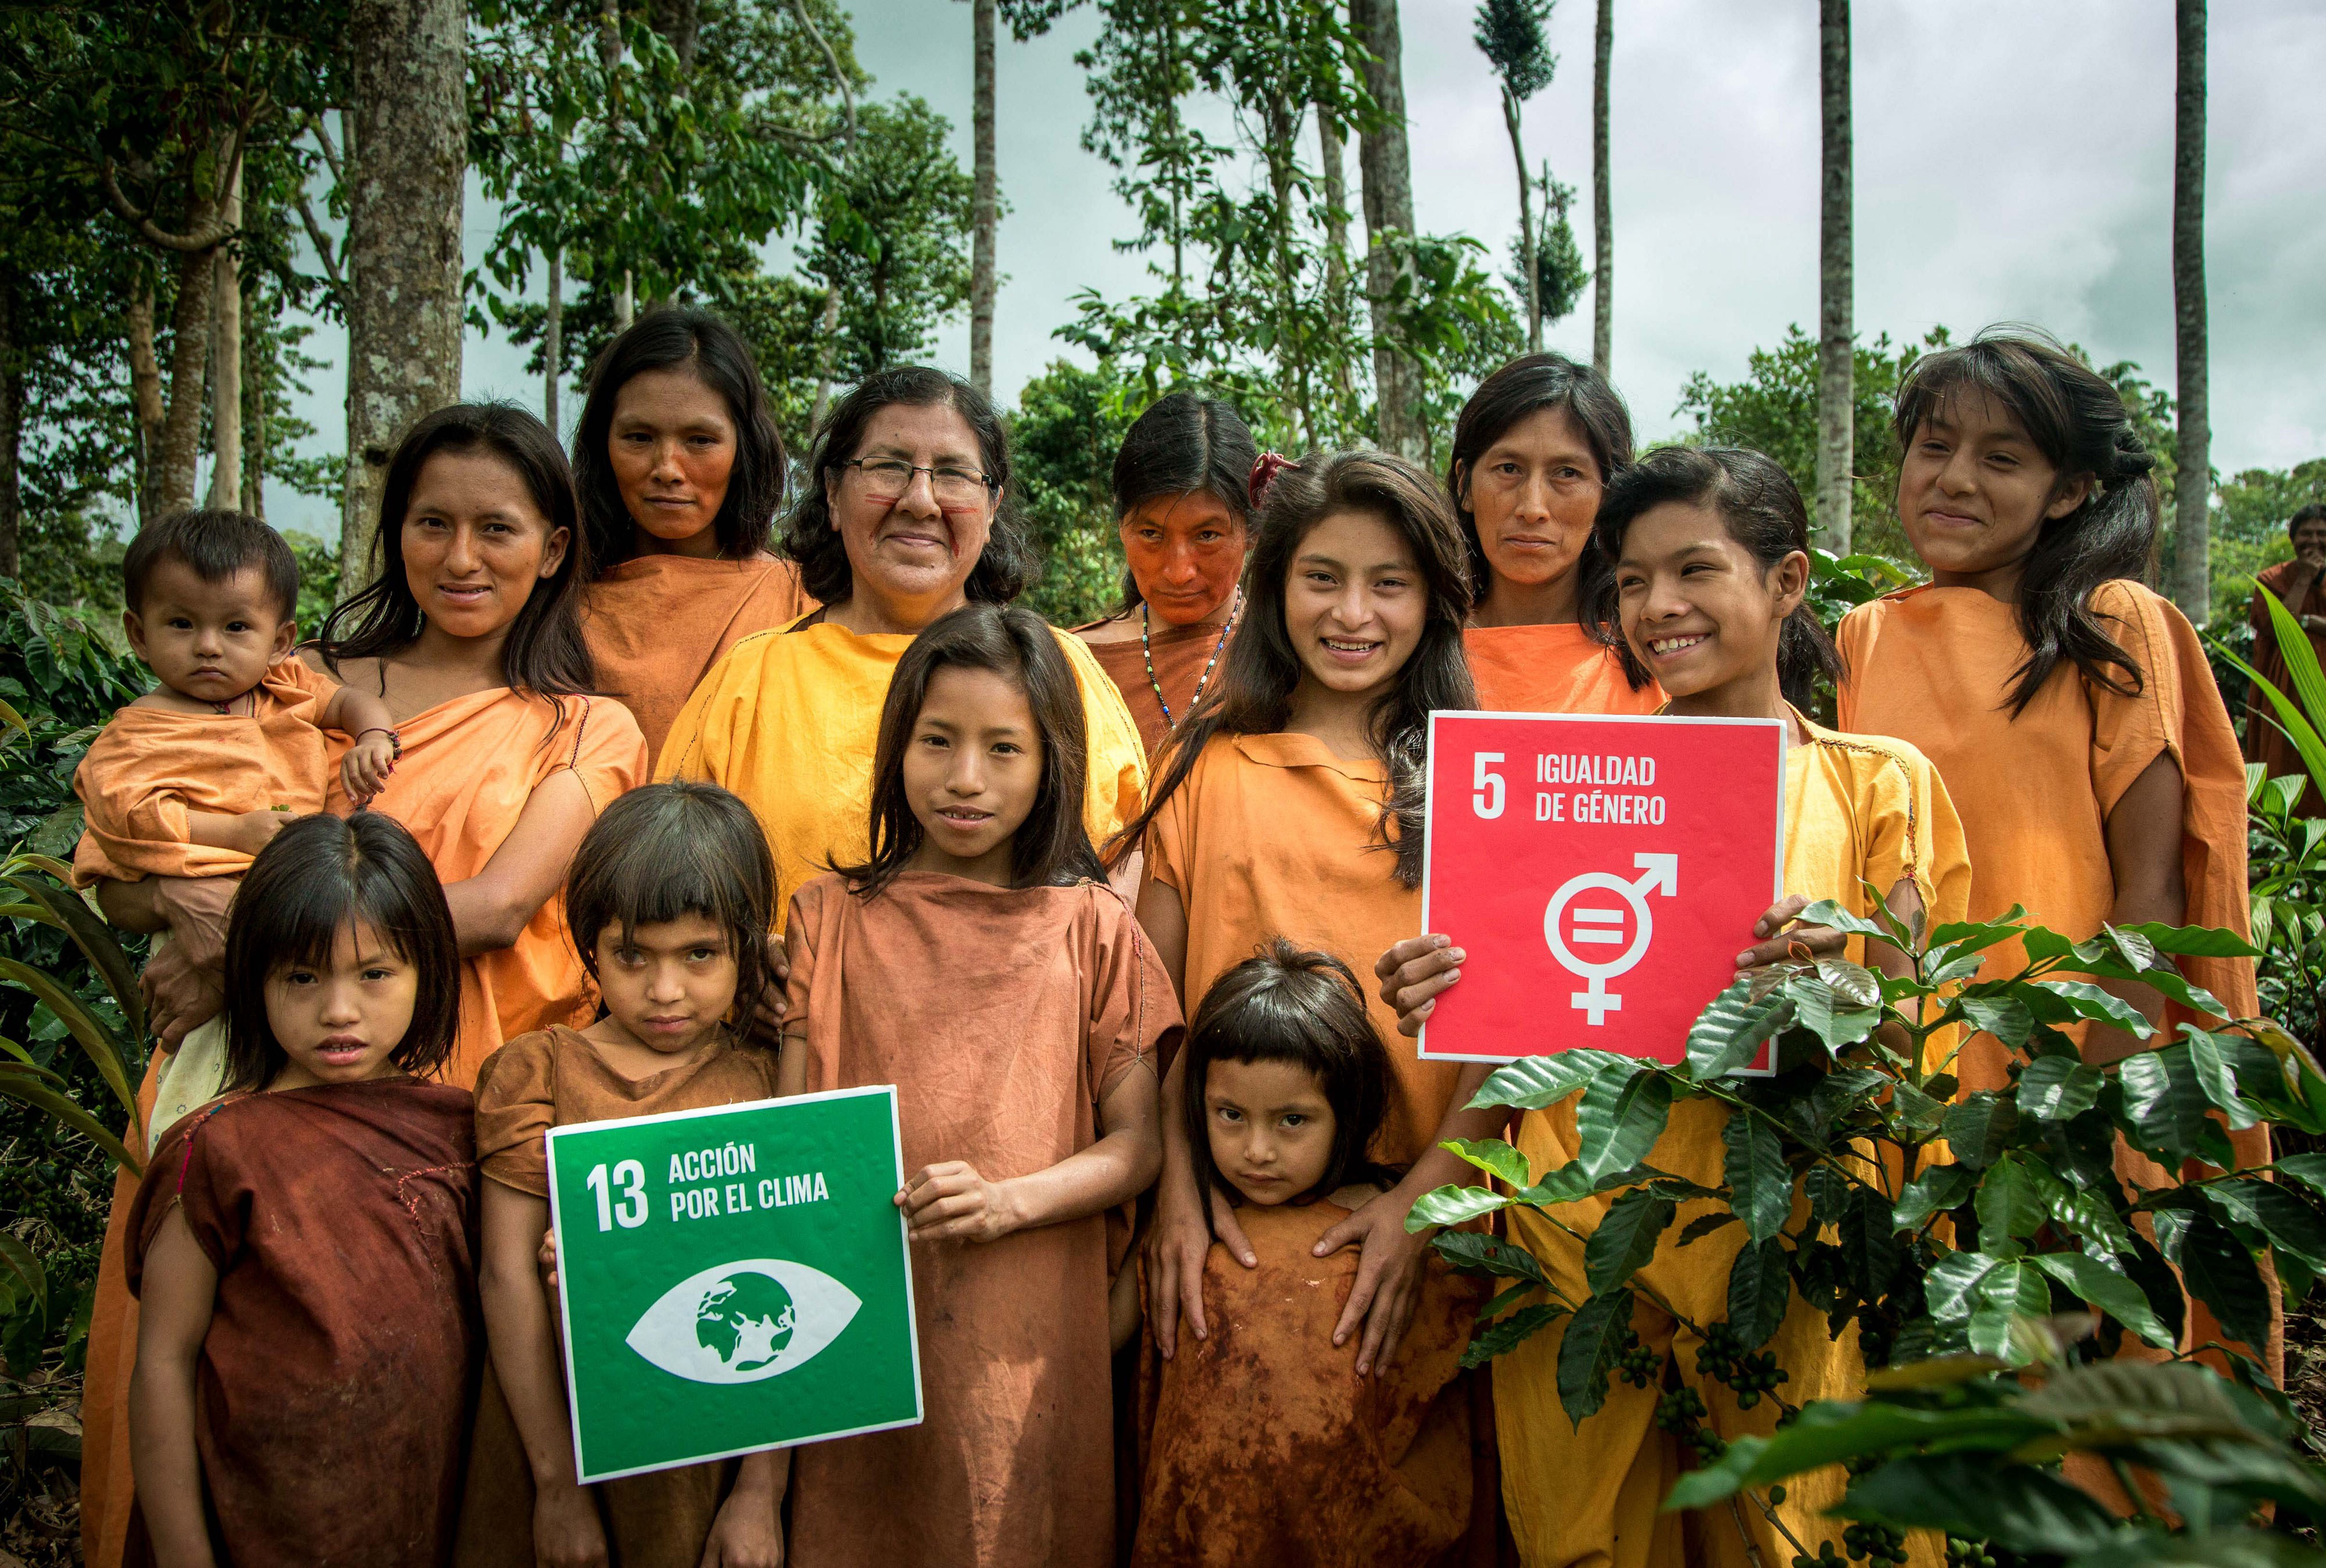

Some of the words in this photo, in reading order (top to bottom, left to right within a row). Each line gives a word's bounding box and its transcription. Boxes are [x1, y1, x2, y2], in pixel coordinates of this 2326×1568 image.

[1472, 752, 1506, 820] 5
[1536, 753, 1656, 786] IGUALDAD
[1535, 792, 1565, 822] DE
[1573, 789, 1666, 825] GÉNERO
[668, 1141, 756, 1184] ACCIÓN
[586, 1159, 649, 1232] 13
[670, 1187, 720, 1221] POR
[725, 1183, 752, 1214] EL
[758, 1171, 829, 1209] CLIMA
